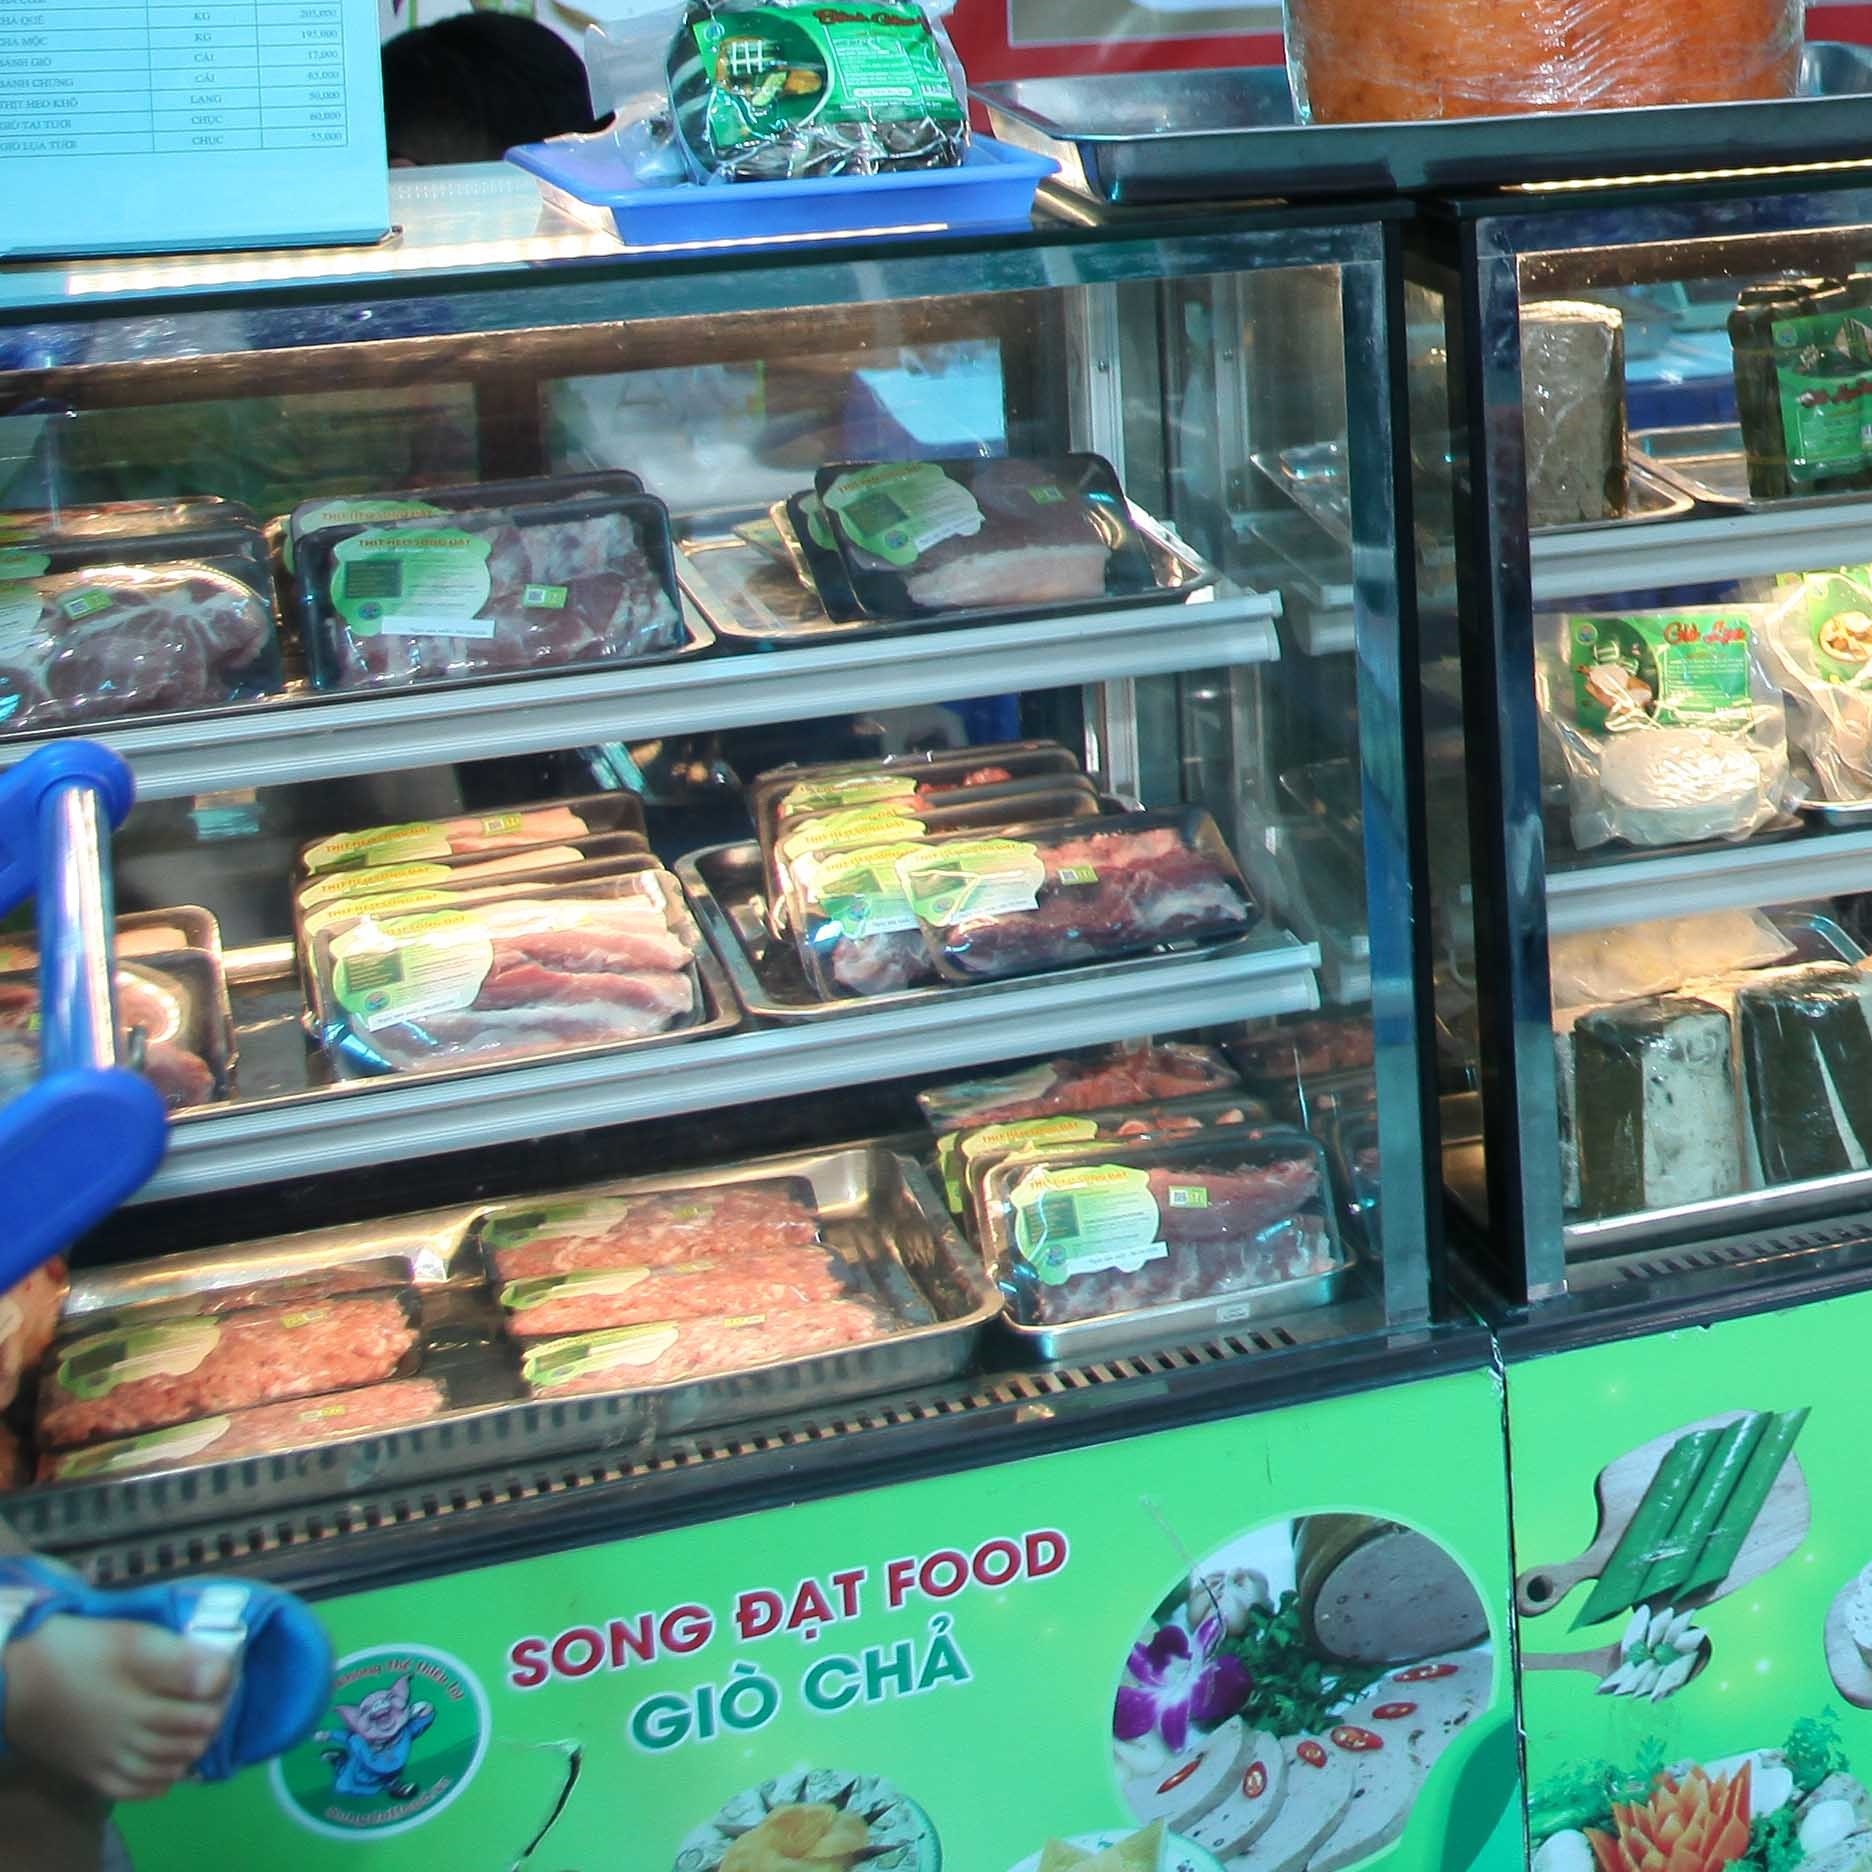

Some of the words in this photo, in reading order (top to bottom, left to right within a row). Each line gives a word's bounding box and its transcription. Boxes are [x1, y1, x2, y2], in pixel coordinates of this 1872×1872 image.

[508, 1604, 713, 1689] SONG
[737, 1569, 861, 1641] ĐẠT
[888, 1529, 1069, 1608] FOOD
[630, 1662, 779, 1753] GIÒ
[802, 1614, 975, 1712] CHẢ
